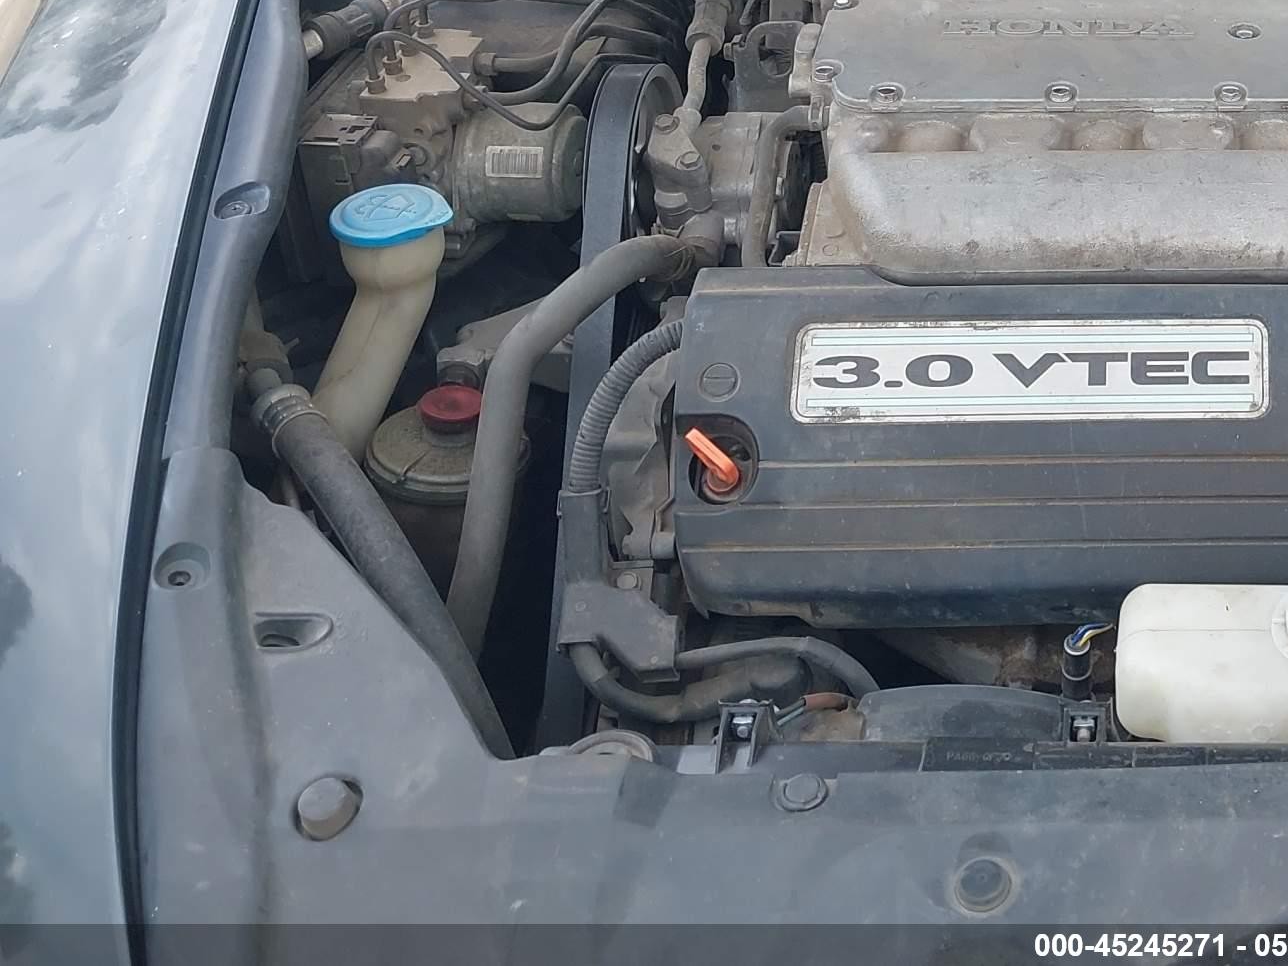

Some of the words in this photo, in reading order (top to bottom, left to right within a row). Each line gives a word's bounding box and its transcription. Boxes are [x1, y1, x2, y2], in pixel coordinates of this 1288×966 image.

[943, 18, 1196, 36] HONDA
[812, 353, 975, 389] 3.0
[991, 350, 1251, 389] VTEC
